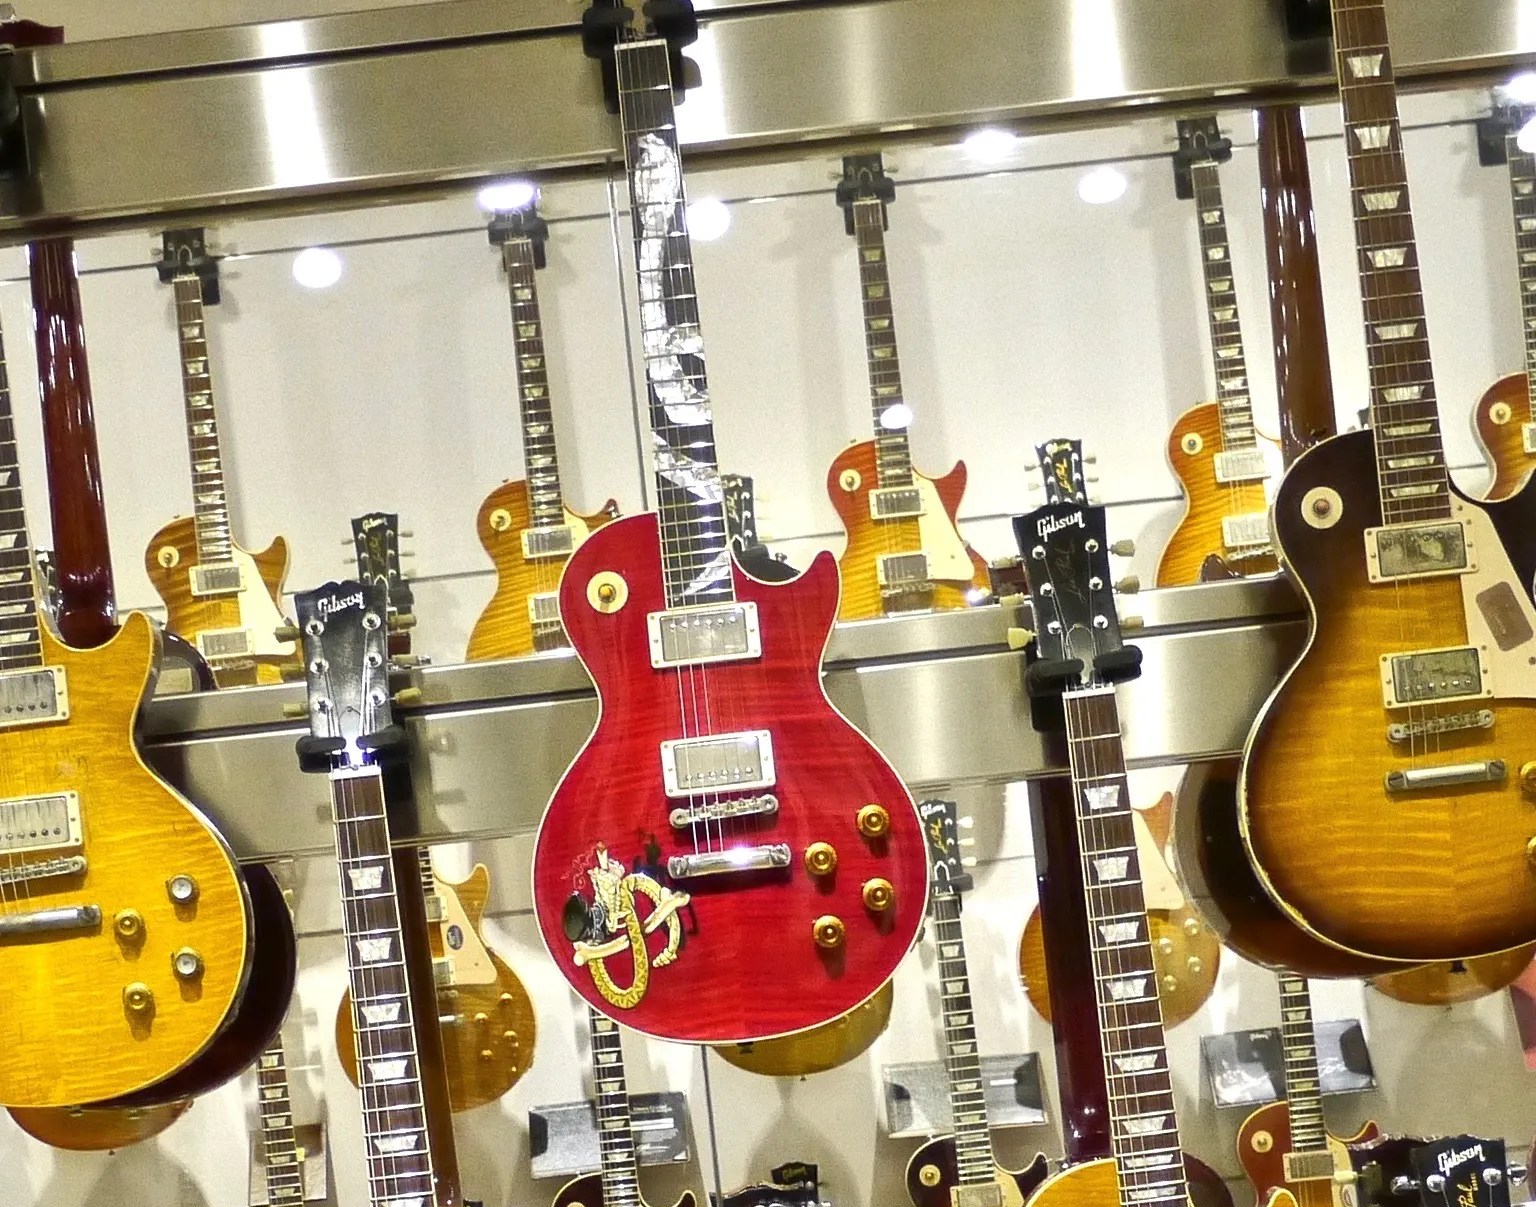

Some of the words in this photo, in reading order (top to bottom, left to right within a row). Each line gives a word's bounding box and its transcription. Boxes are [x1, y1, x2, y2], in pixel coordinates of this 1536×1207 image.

[1037, 510, 1086, 542] Gibson
[317, 591, 365, 622] Gibson
[1437, 1143, 1485, 1176] Gibson
